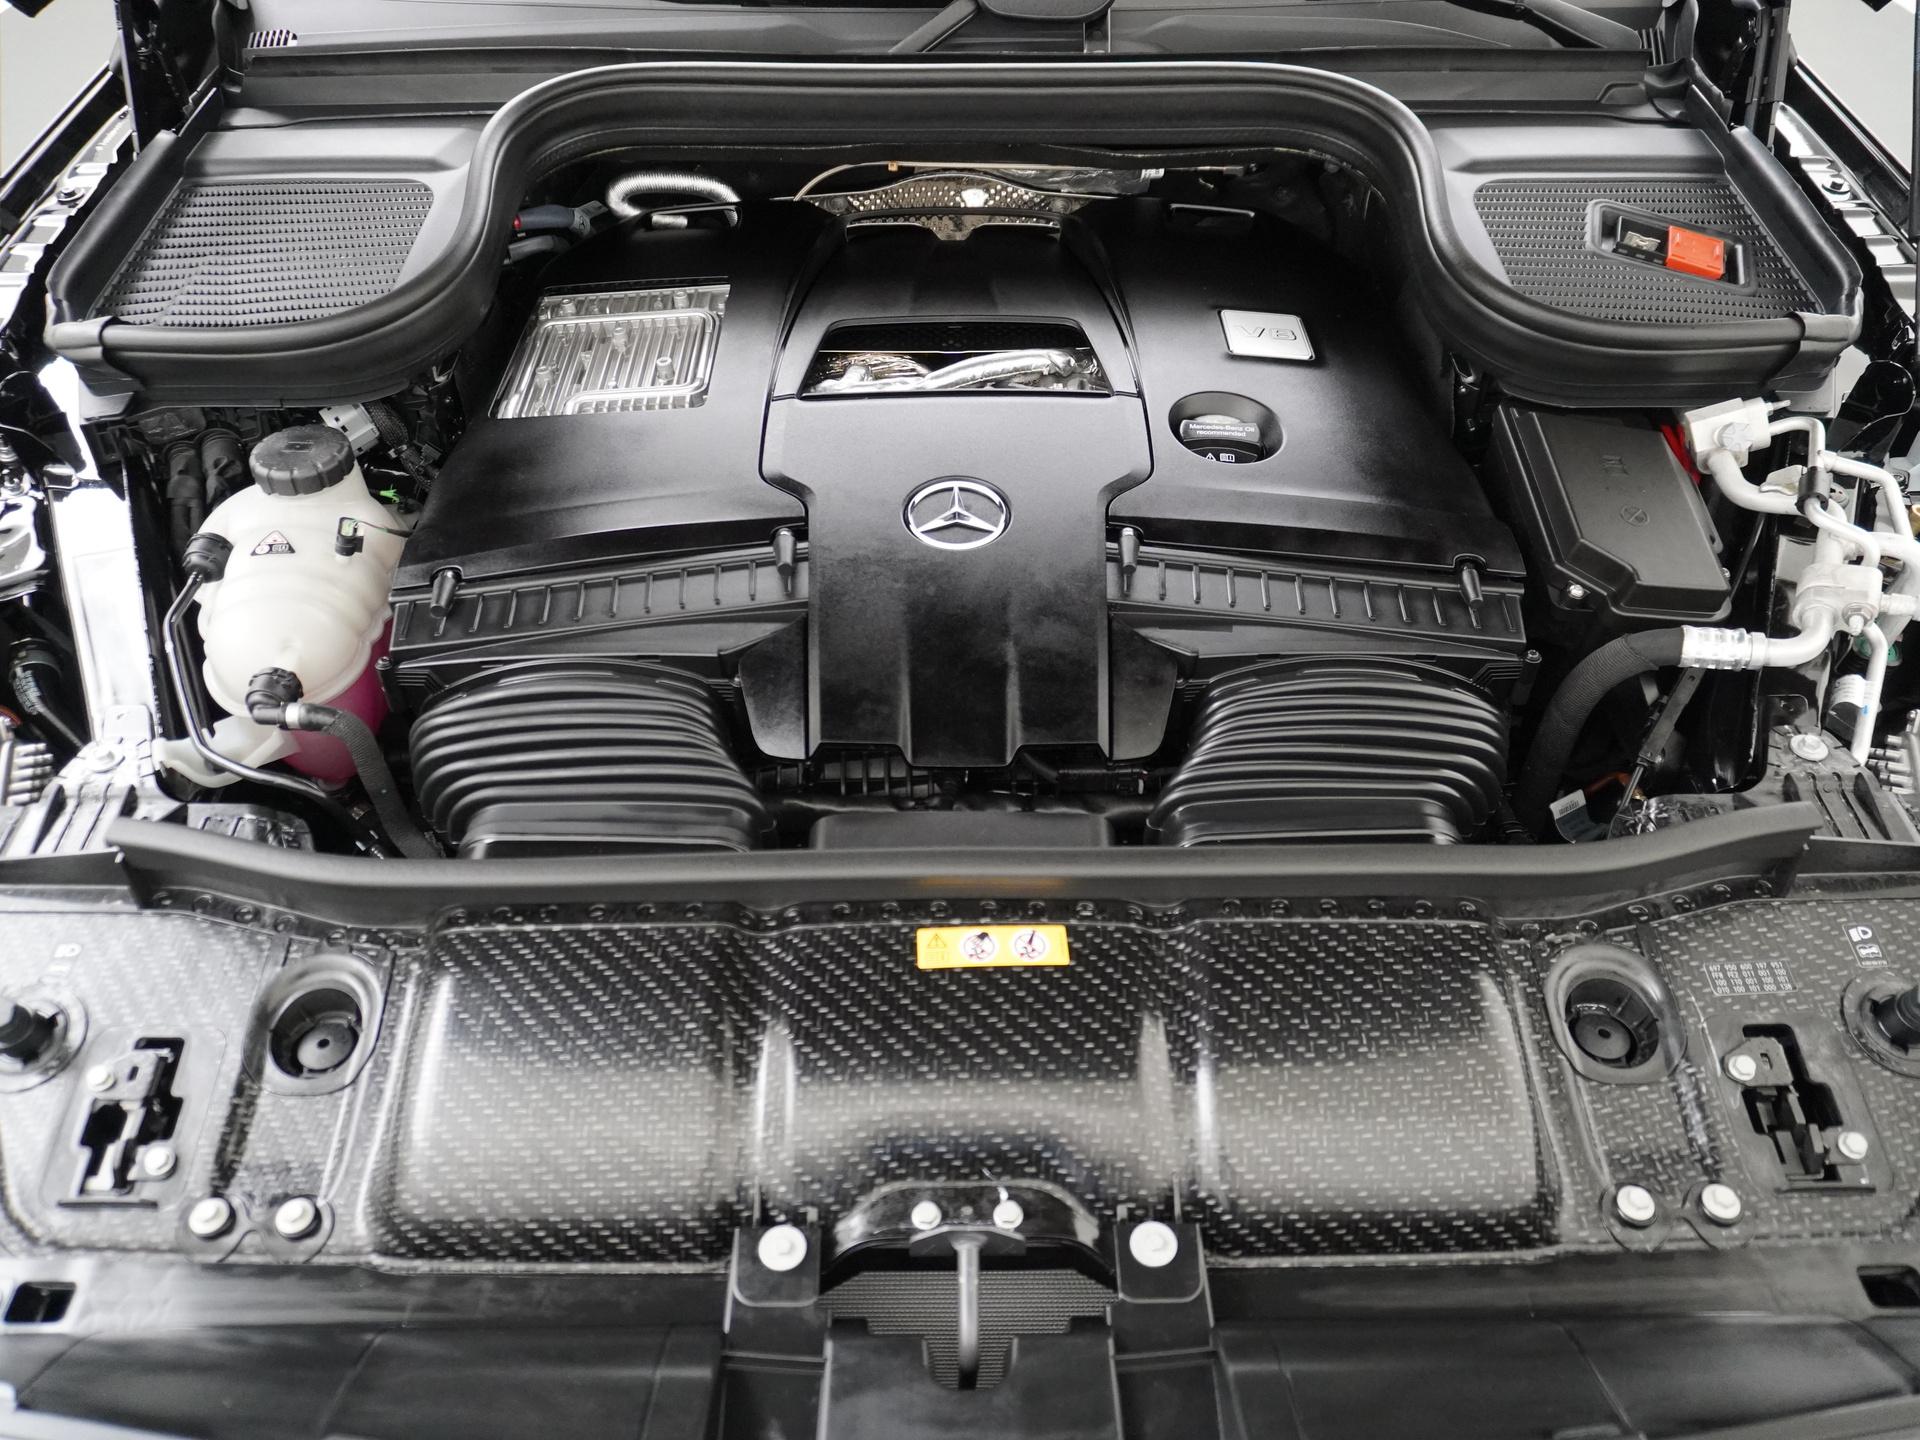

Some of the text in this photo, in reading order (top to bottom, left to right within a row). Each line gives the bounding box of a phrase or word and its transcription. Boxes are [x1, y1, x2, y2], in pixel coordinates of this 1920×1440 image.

[1232, 325, 1297, 341] V8
[1189, 423, 1244, 432] Mercedes-Benz
[1196, 429, 1247, 437] recommended
[1742, 970, 1755, 978] 011
[1758, 969, 1770, 977] 001
[1774, 968, 1787, 976] 100
[1730, 978, 1743, 986] 110
[1745, 977, 1758, 985] 001
[1777, 975, 1789, 983] 101
[1717, 986, 1730, 994] 010
[1733, 985, 1746, 993] 100
[1748, 984, 1761, 992] 101
